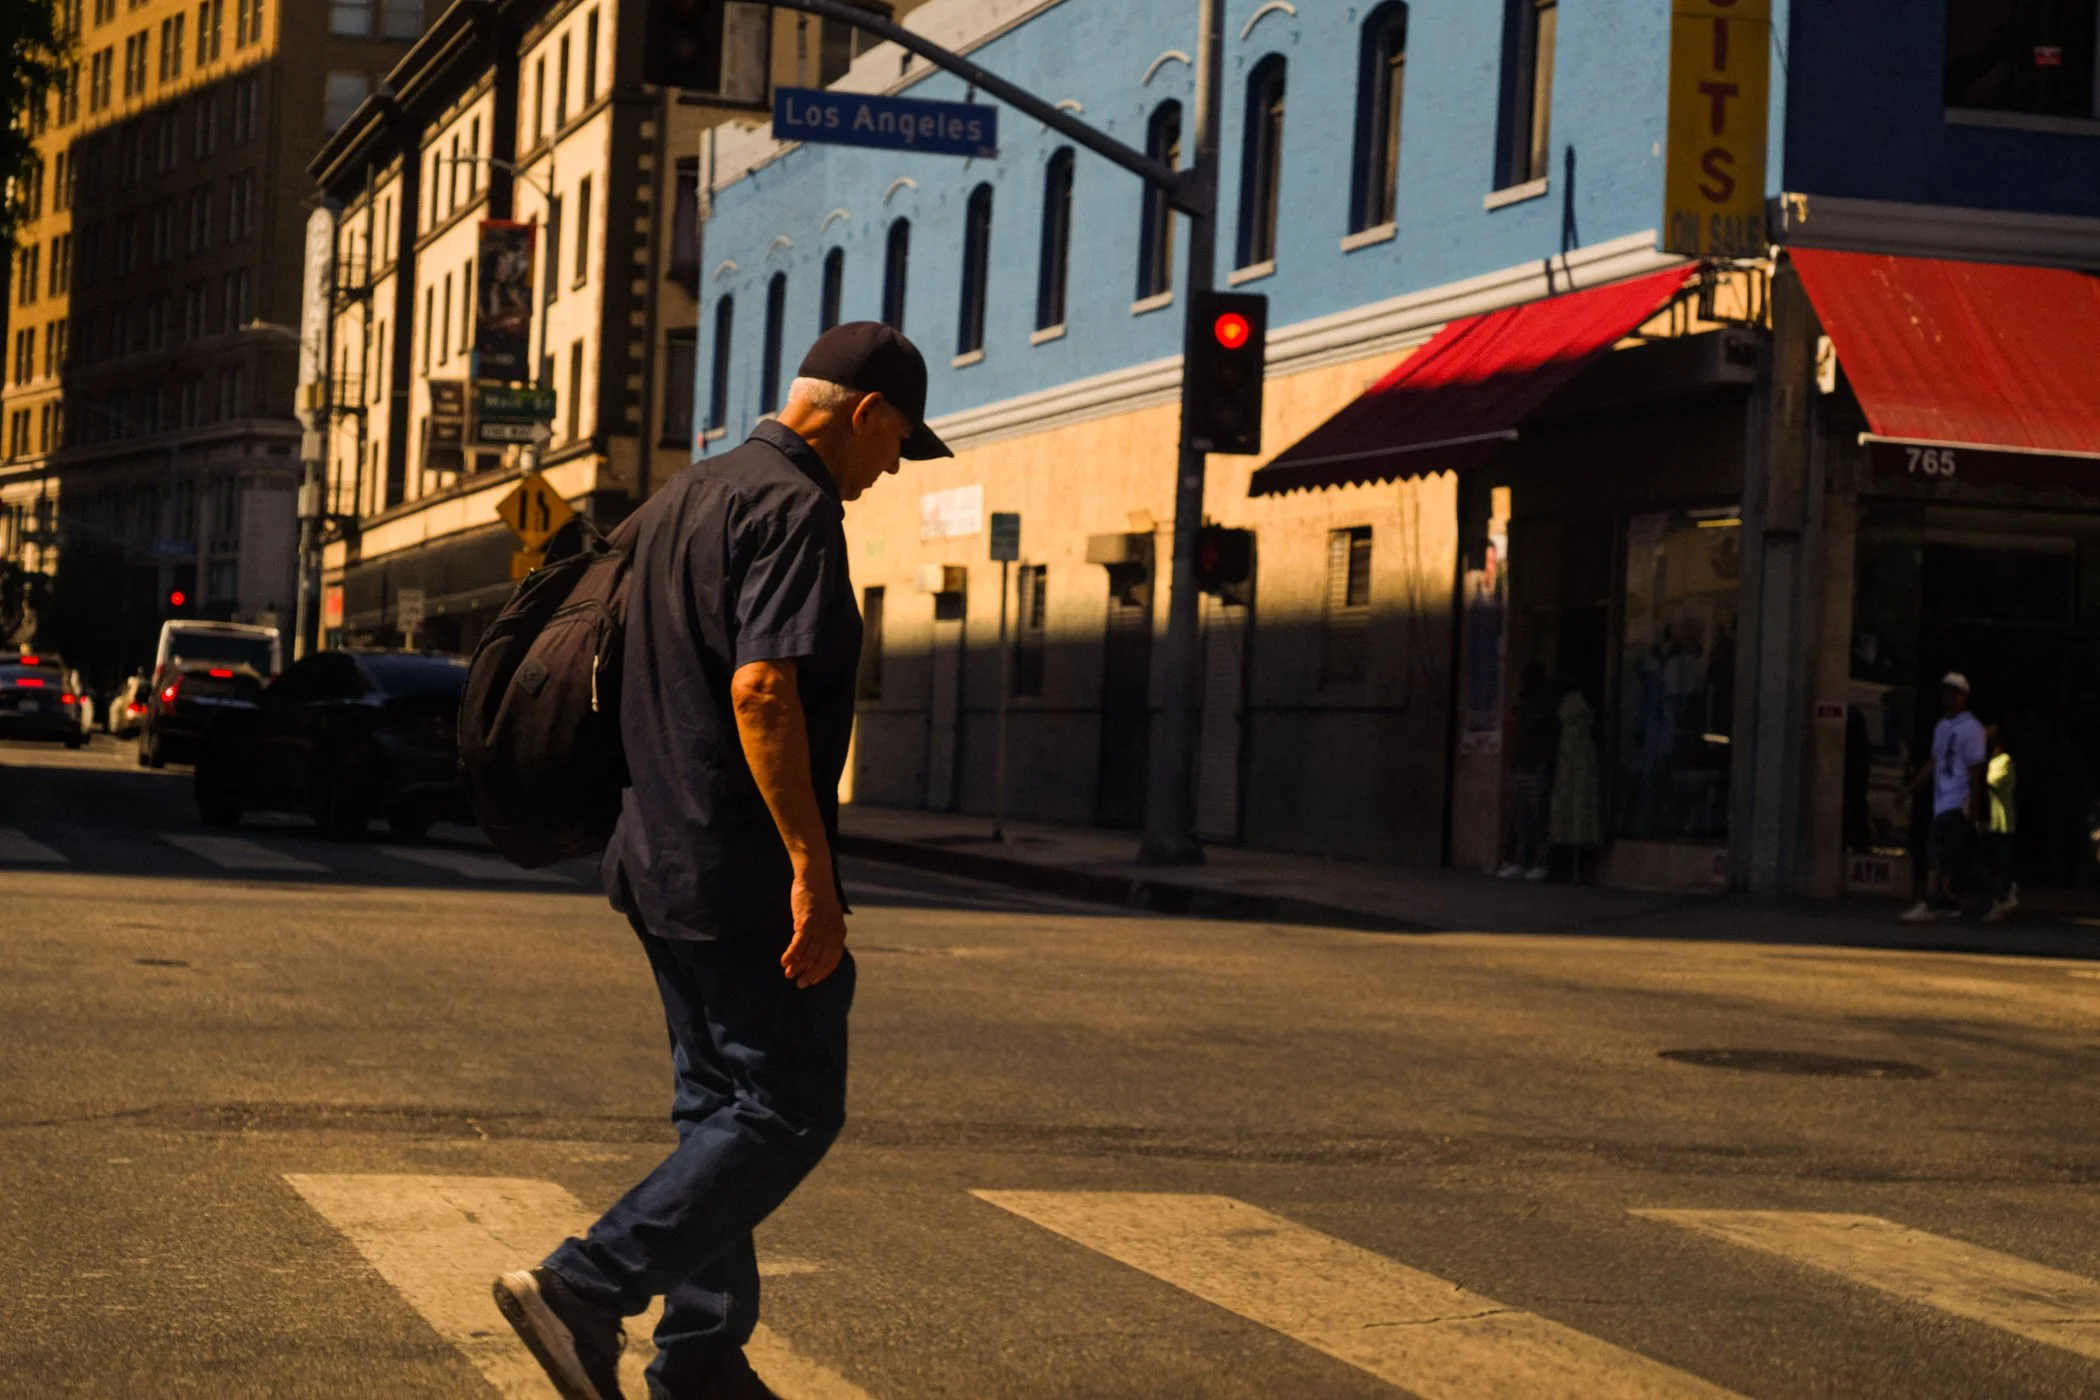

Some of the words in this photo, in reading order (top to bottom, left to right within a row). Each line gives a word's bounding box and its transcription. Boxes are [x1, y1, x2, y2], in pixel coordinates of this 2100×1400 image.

[785, 97, 841, 129] Los
[852, 104, 983, 144] Angeles
[1698, 0, 1740, 204] ITS
[1905, 447, 1956, 477] 765
[1853, 860, 1890, 885] ATM
